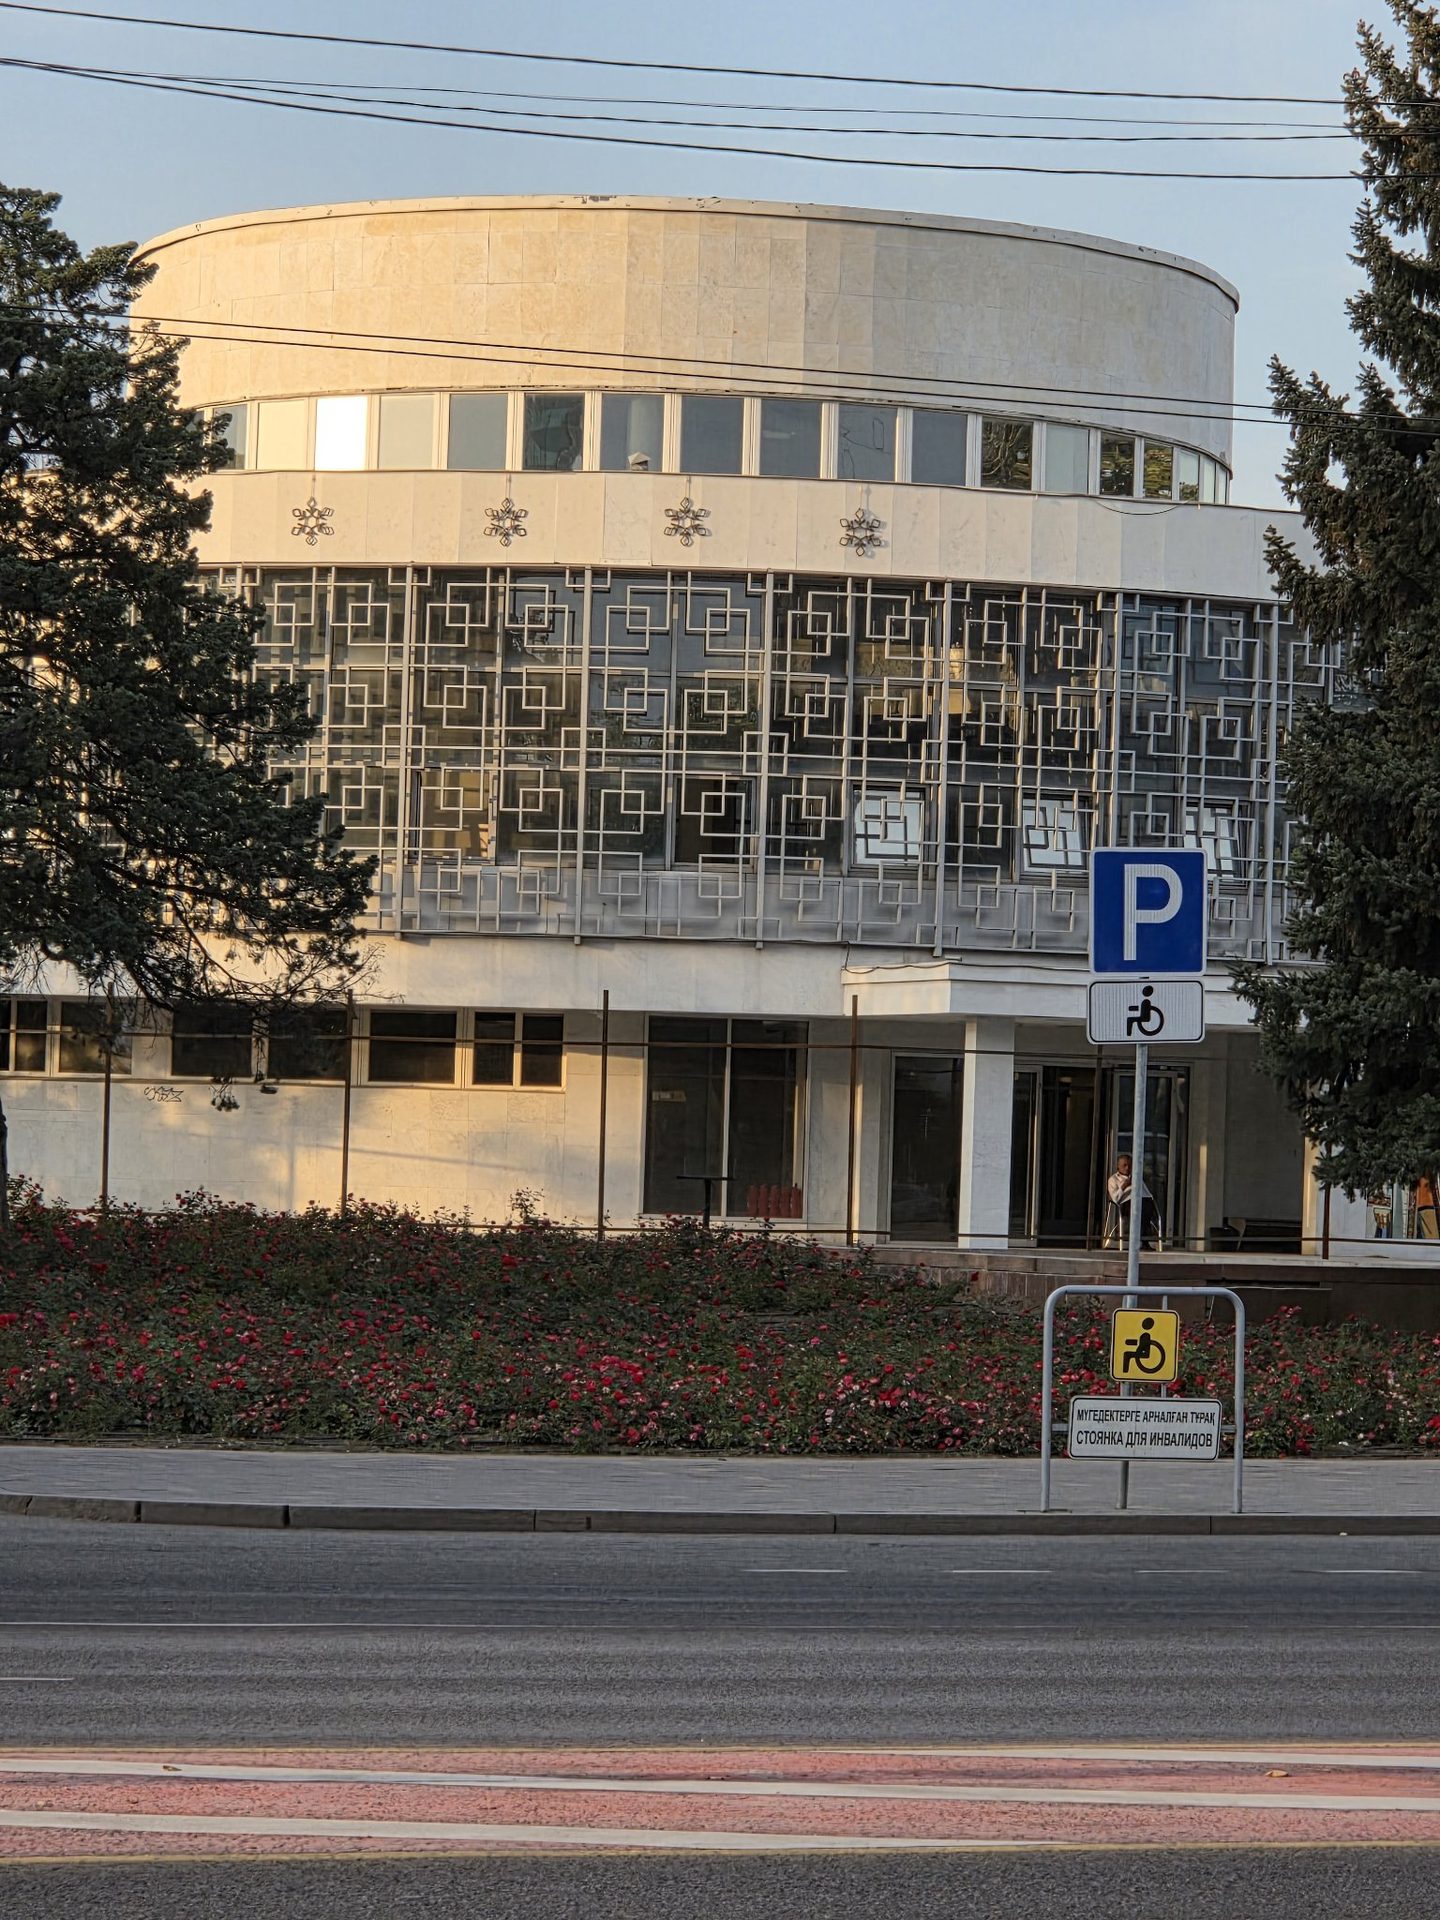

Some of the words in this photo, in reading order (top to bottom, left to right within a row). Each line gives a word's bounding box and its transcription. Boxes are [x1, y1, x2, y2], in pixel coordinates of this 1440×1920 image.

[1124, 864, 1183, 960] P
[1076, 1430, 1123, 1445] СТОЯНКА
[1125, 1431, 1147, 1448] ДЛЯ
[1149, 1432, 1213, 1450] ИНВАЛИДОВ
